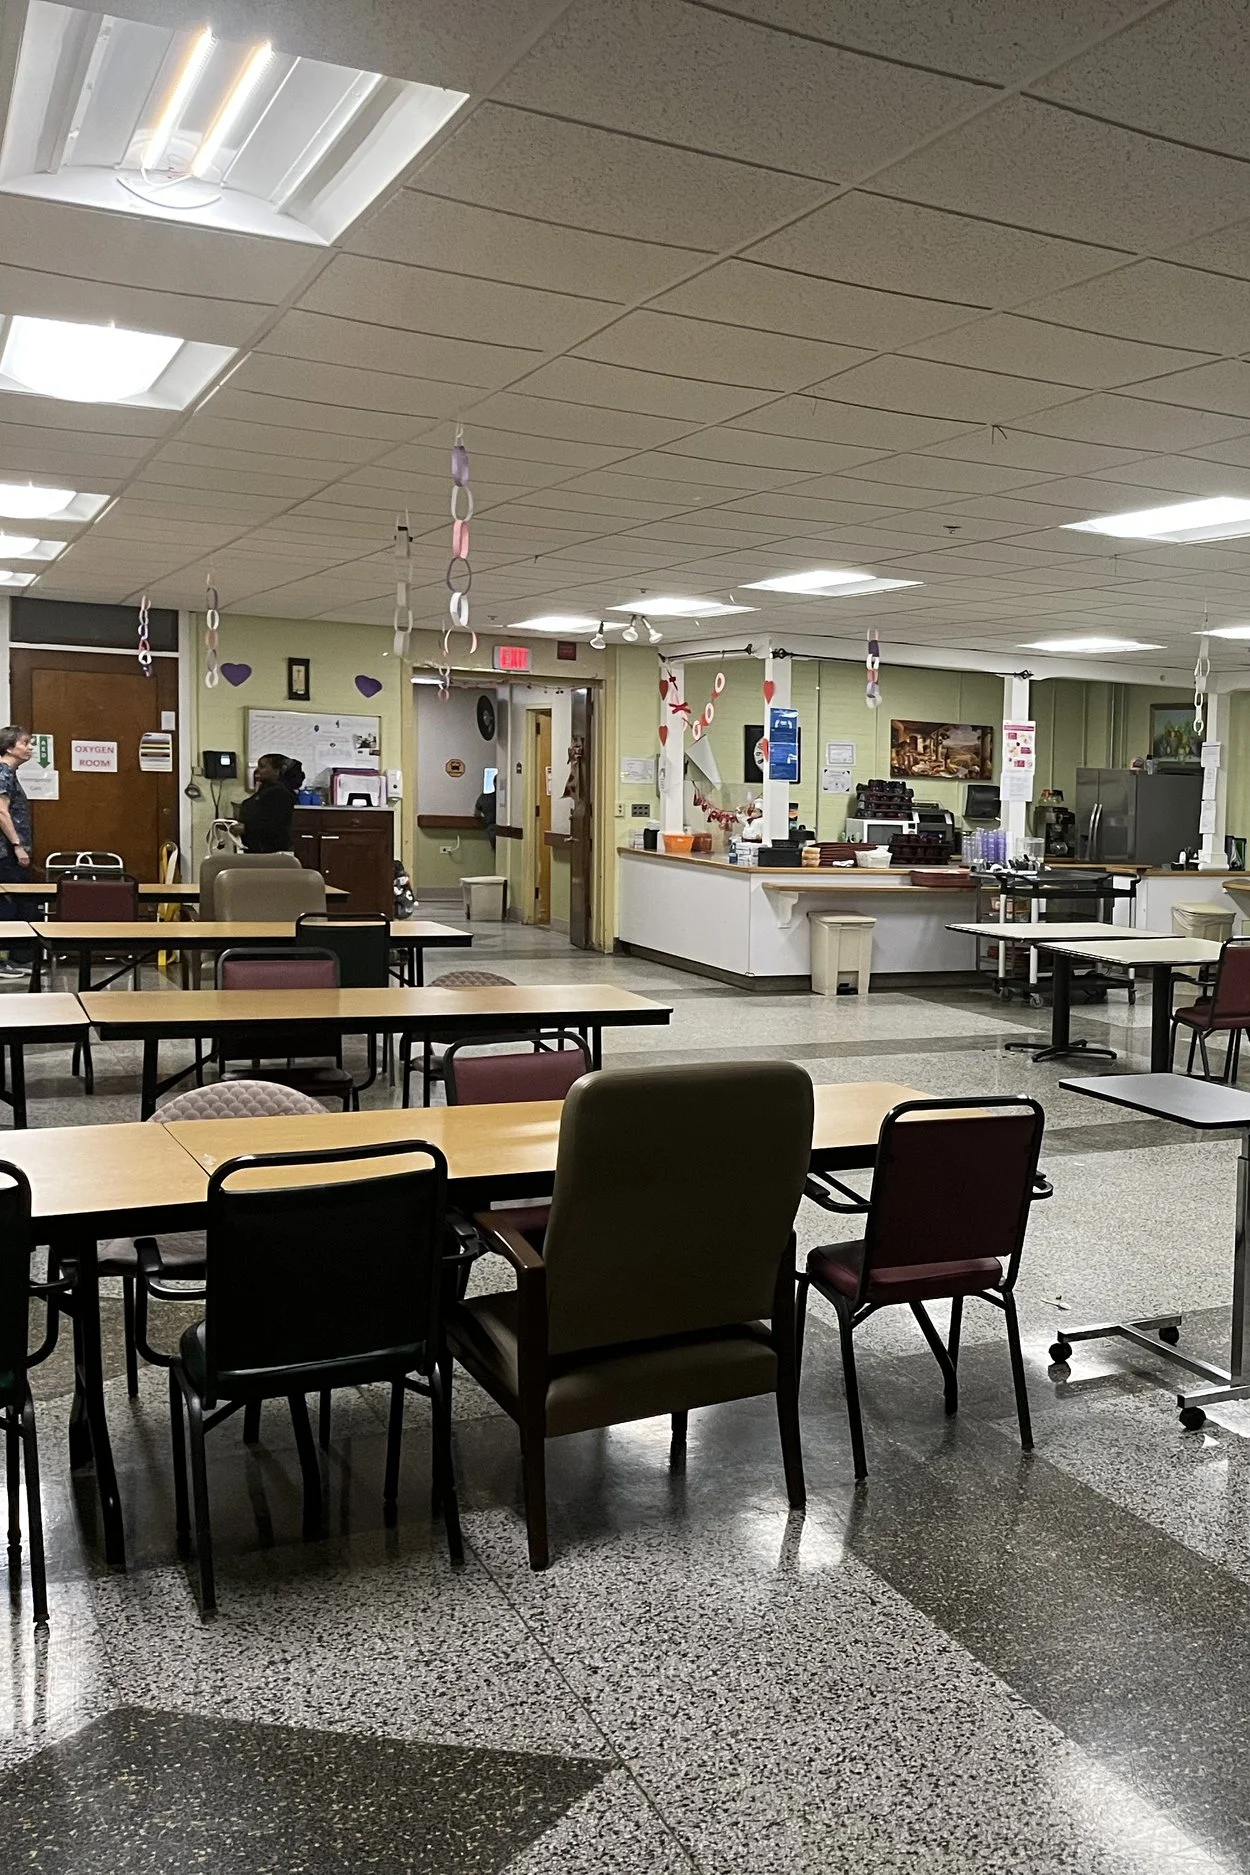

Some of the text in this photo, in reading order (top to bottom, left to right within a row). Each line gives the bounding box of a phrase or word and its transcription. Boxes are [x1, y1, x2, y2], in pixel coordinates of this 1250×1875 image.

[500, 646, 528, 669] EXIT
[75, 745, 114, 754] OXYGEN
[79, 759, 110, 767] ROOM
